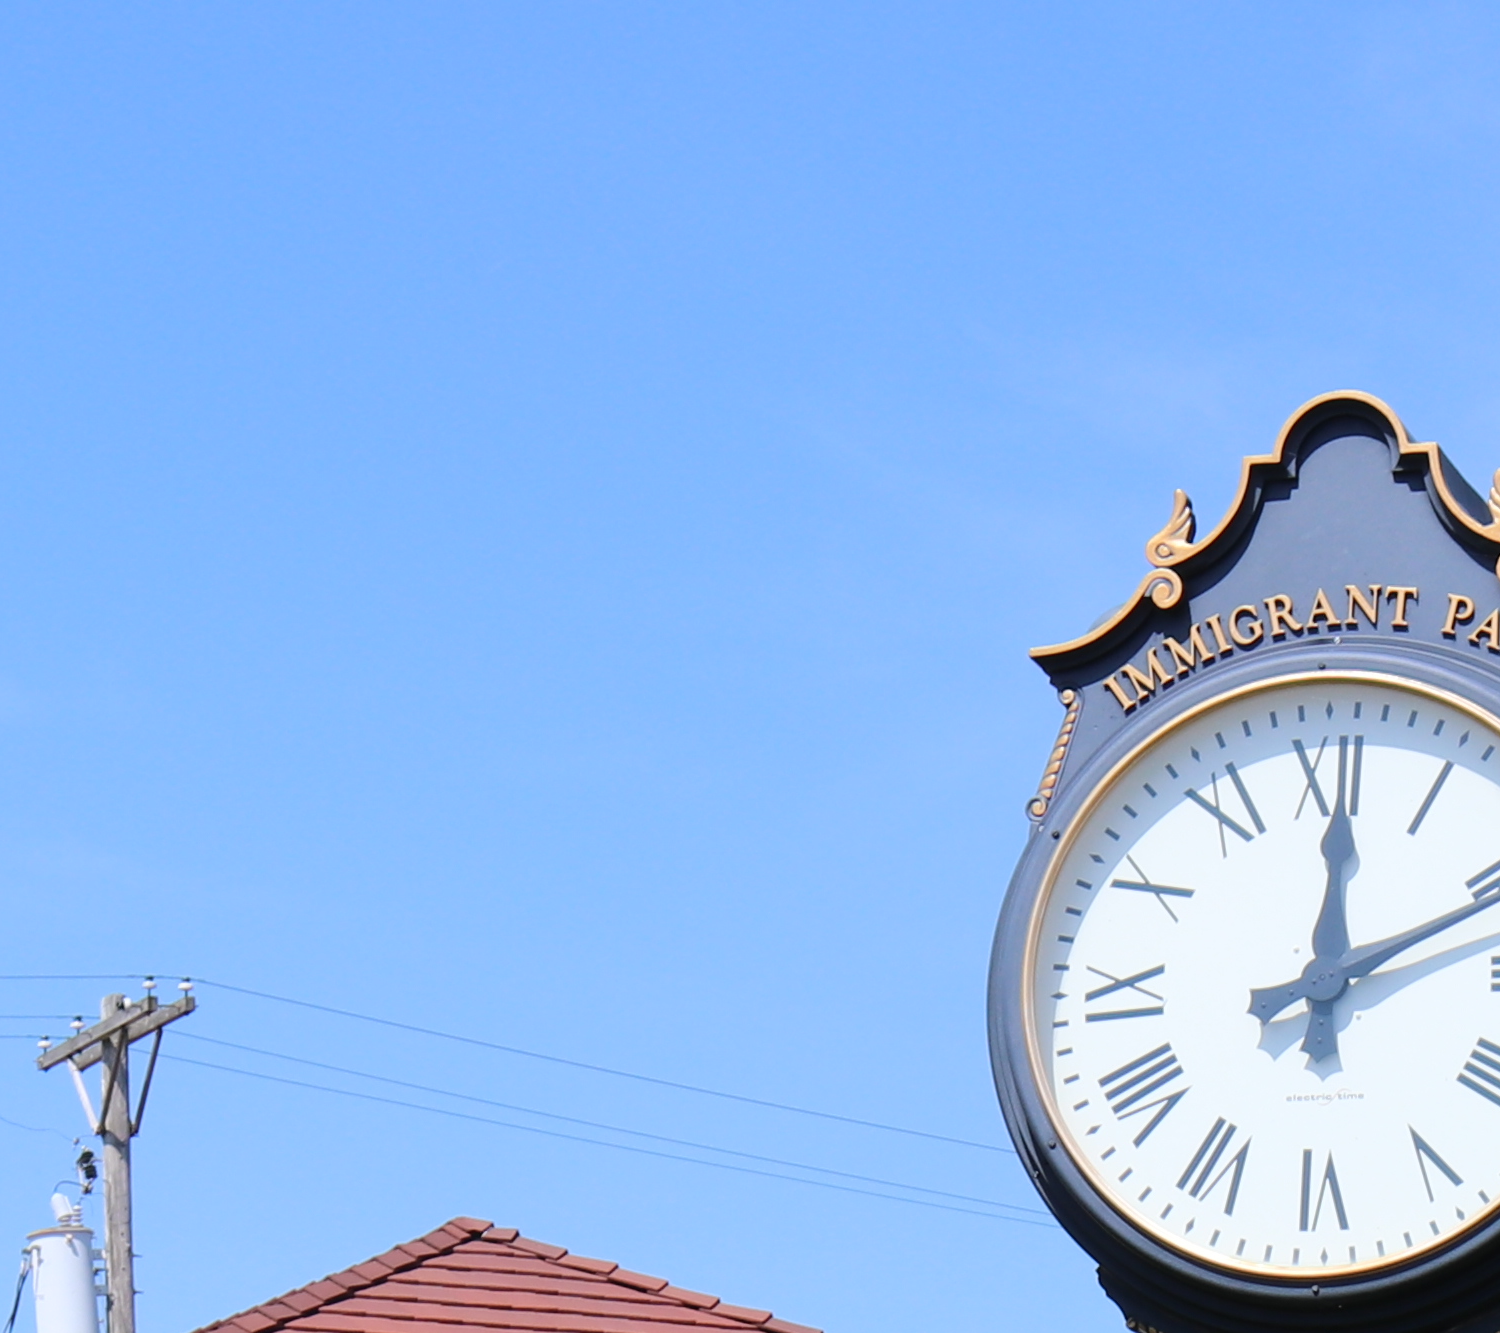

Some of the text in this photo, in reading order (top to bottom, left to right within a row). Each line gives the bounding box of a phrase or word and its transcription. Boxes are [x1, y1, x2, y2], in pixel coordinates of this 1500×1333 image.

[1103, 584, 1418, 714] IMMIGRANT
[1184, 761, 1266, 858] XI
[1292, 733, 1364, 820] XII
[1407, 761, 1454, 835] I
[1110, 854, 1195, 922] X
[1085, 963, 1166, 1022] IX
[1098, 1042, 1191, 1147] VIII
[1285, 1092, 1365, 1102] electric time
[1176, 1117, 1252, 1216] VII
[1299, 1149, 1349, 1232] VI
[1408, 1124, 1464, 1203] V
